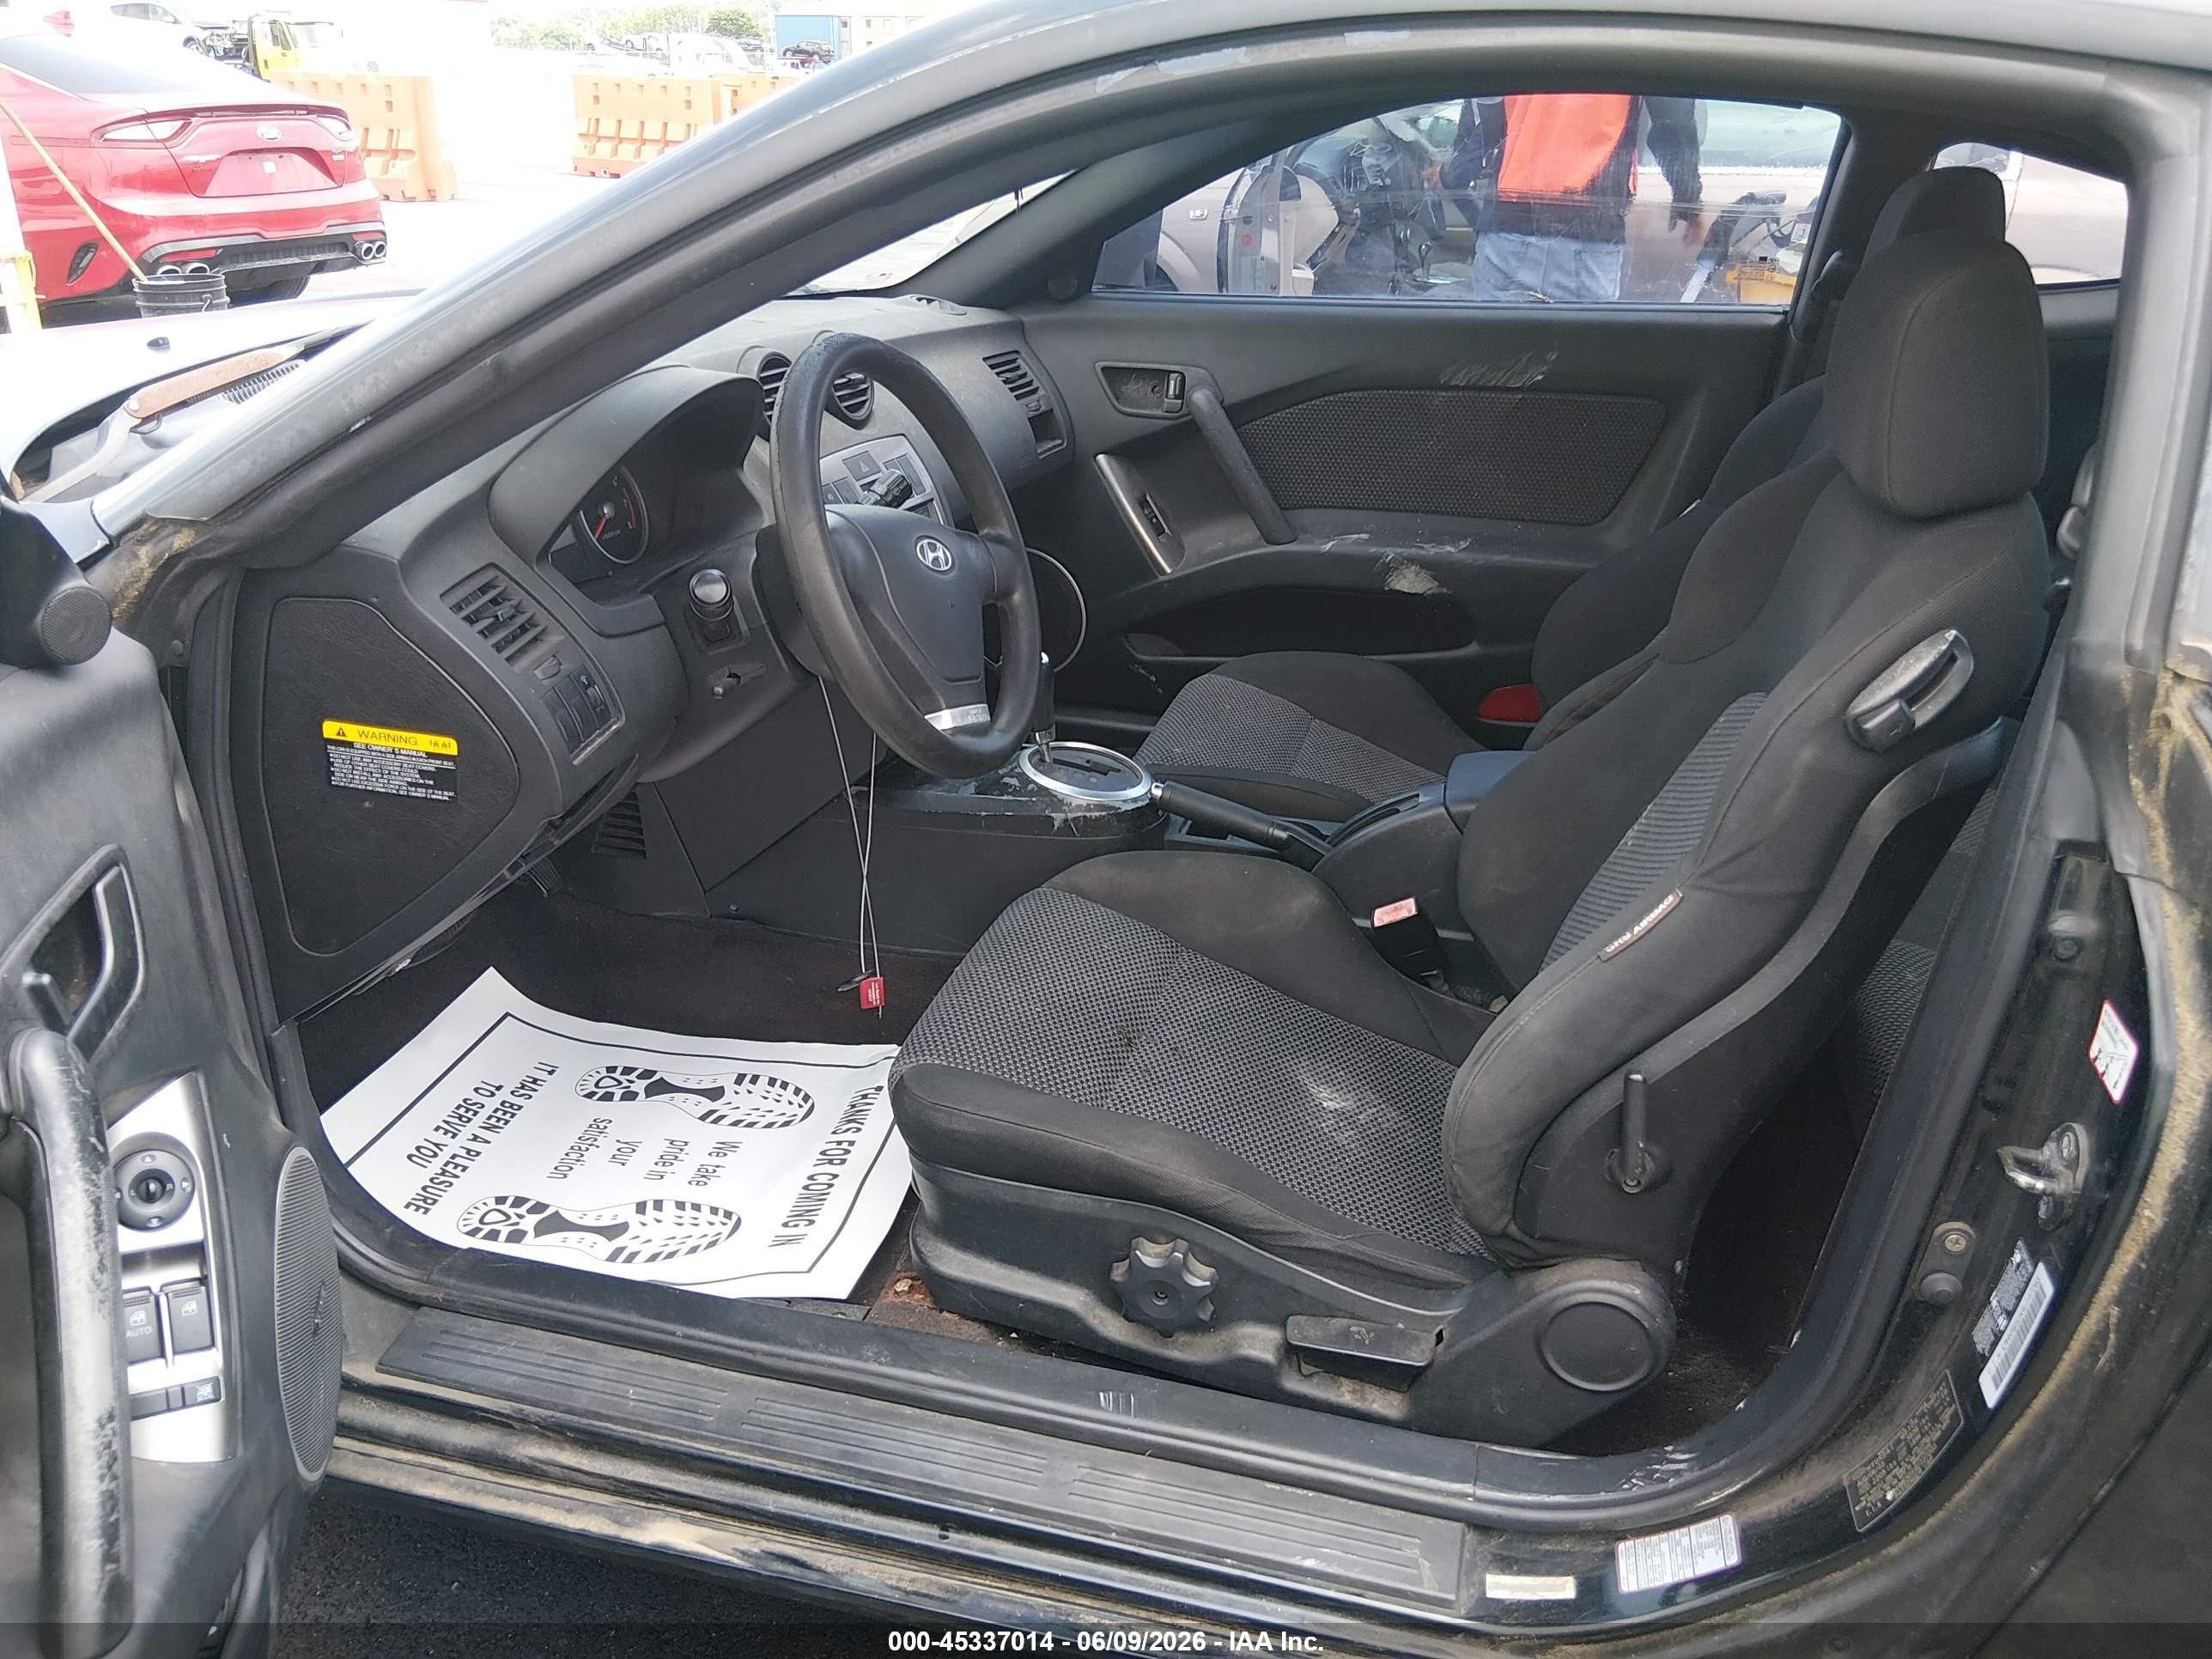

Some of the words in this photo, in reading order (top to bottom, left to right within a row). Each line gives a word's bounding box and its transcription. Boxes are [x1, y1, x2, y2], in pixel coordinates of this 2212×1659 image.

[357, 729, 418, 746] WARNING
[533, 1061, 559, 1076] IT
[473, 1080, 505, 1098] TO
[509, 1075, 547, 1100] HAS
[433, 1097, 485, 1139] SERVE
[477, 1100, 525, 1134] BEEN
[830, 1085, 884, 1135] THANKS
[466, 1133, 492, 1145] A
[546, 1117, 613, 1180] satisfaction
[708, 1141, 744, 1158] We
[405, 1138, 449, 1169] YOU
[607, 1139, 643, 1167] your
[653, 1139, 690, 1168] pride
[812, 1140, 856, 1167] FOR
[403, 1146, 483, 1215] PLEASURE
[643, 1170, 676, 1181] in
[687, 1164, 726, 1187] take
[781, 1172, 840, 1228] COMING
[768, 1233, 808, 1248] IN
